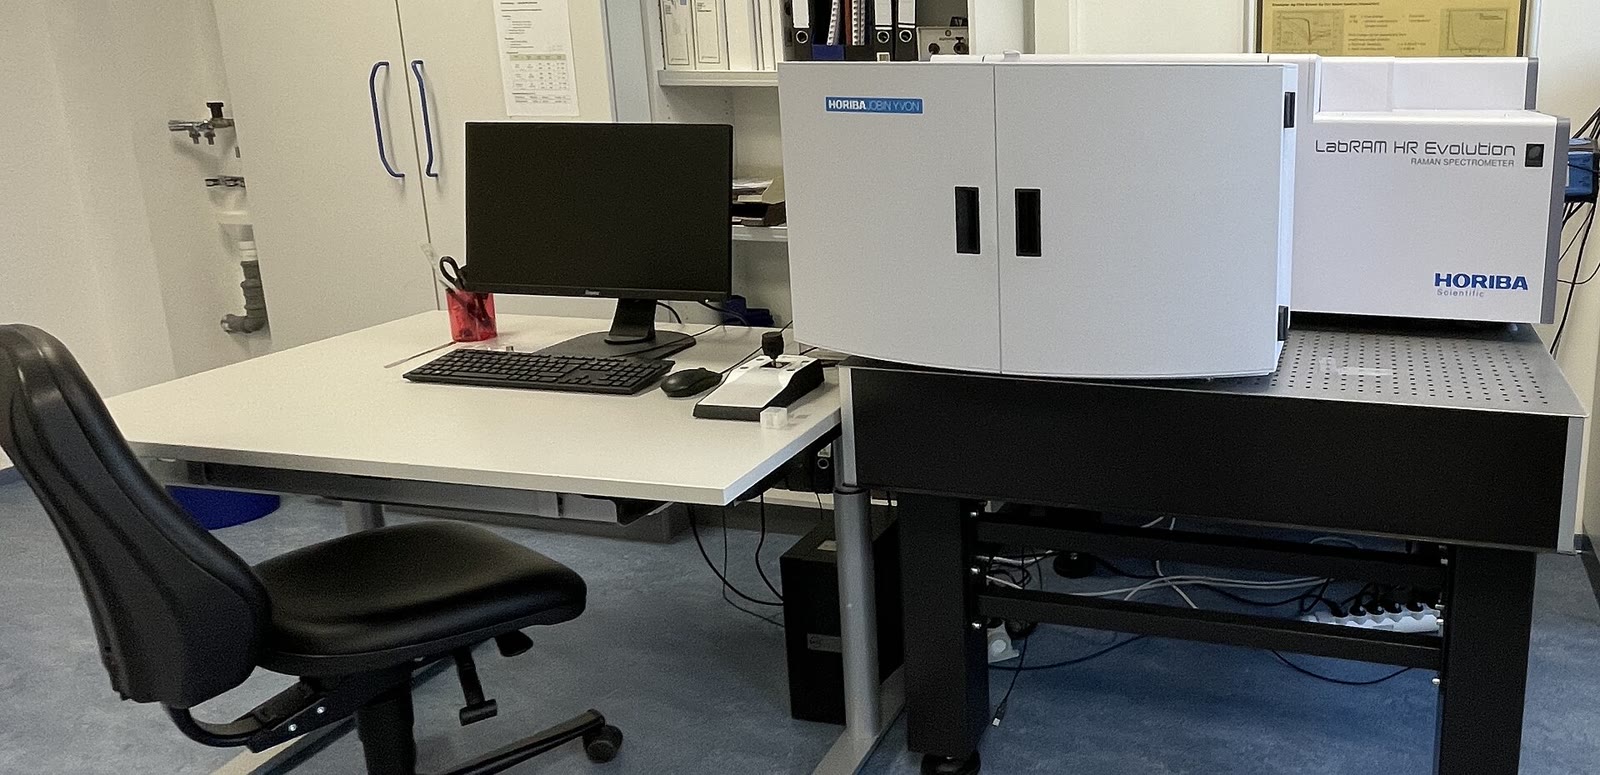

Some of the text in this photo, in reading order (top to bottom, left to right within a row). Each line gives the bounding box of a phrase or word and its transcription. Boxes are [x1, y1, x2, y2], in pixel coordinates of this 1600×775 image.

[828, 99, 920, 112] HORIBA JOBIN YVON
[1315, 140, 1516, 156] LabRAM HR Evolution
[1411, 157, 1515, 167] RAMAN SPECTROMETER
[1434, 272, 1528, 290] HORIBA
[1437, 289, 1484, 298] Scientific
